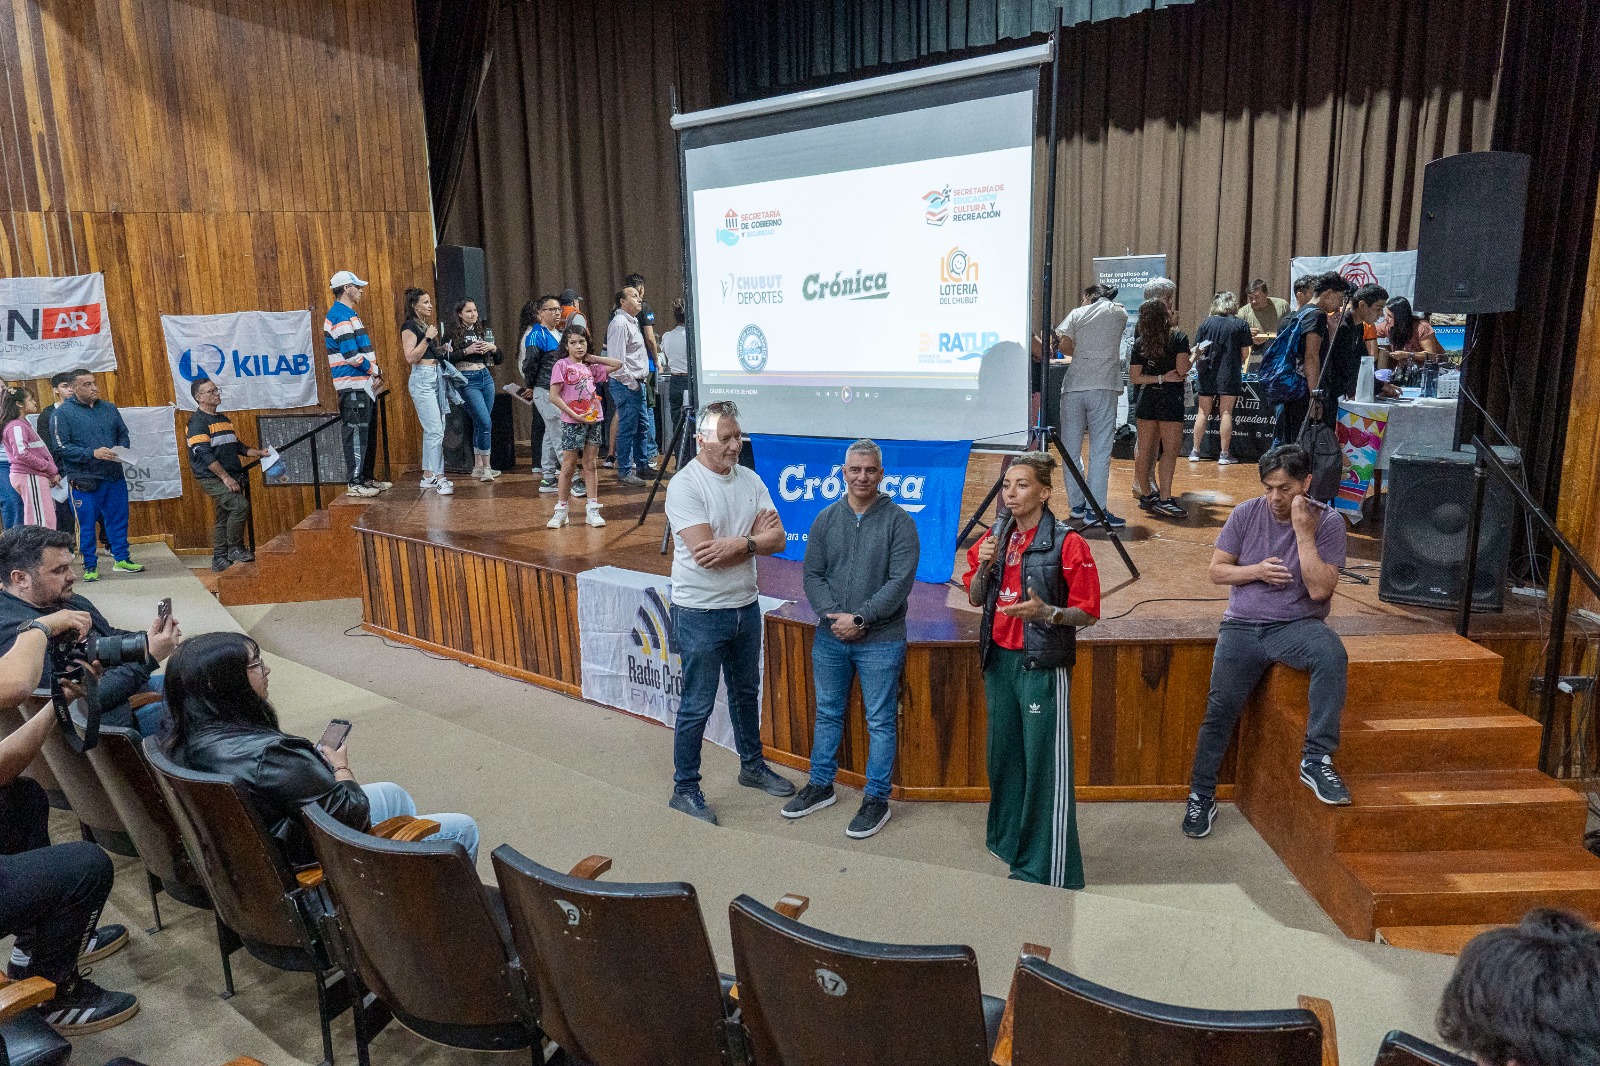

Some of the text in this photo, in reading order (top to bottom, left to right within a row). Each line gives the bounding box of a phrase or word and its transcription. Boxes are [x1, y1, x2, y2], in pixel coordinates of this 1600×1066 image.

[953, 202, 996, 214] CULTURA Y
[741, 219, 783, 230] DE GOBIERNO
[737, 274, 782, 290] CHUBUT
[802, 269, 888, 301] Crónica
[940, 284, 978, 296] LOTERIA
[738, 291, 783, 305] DEPORTES
[940, 296, 978, 305] DEL CHUBUT
[0, 309, 91, 341] N AR
[39, 340, 85, 351] INTEGRAL
[778, 463, 926, 502] Cróca
[628, 654, 682, 696] Radio Cró
